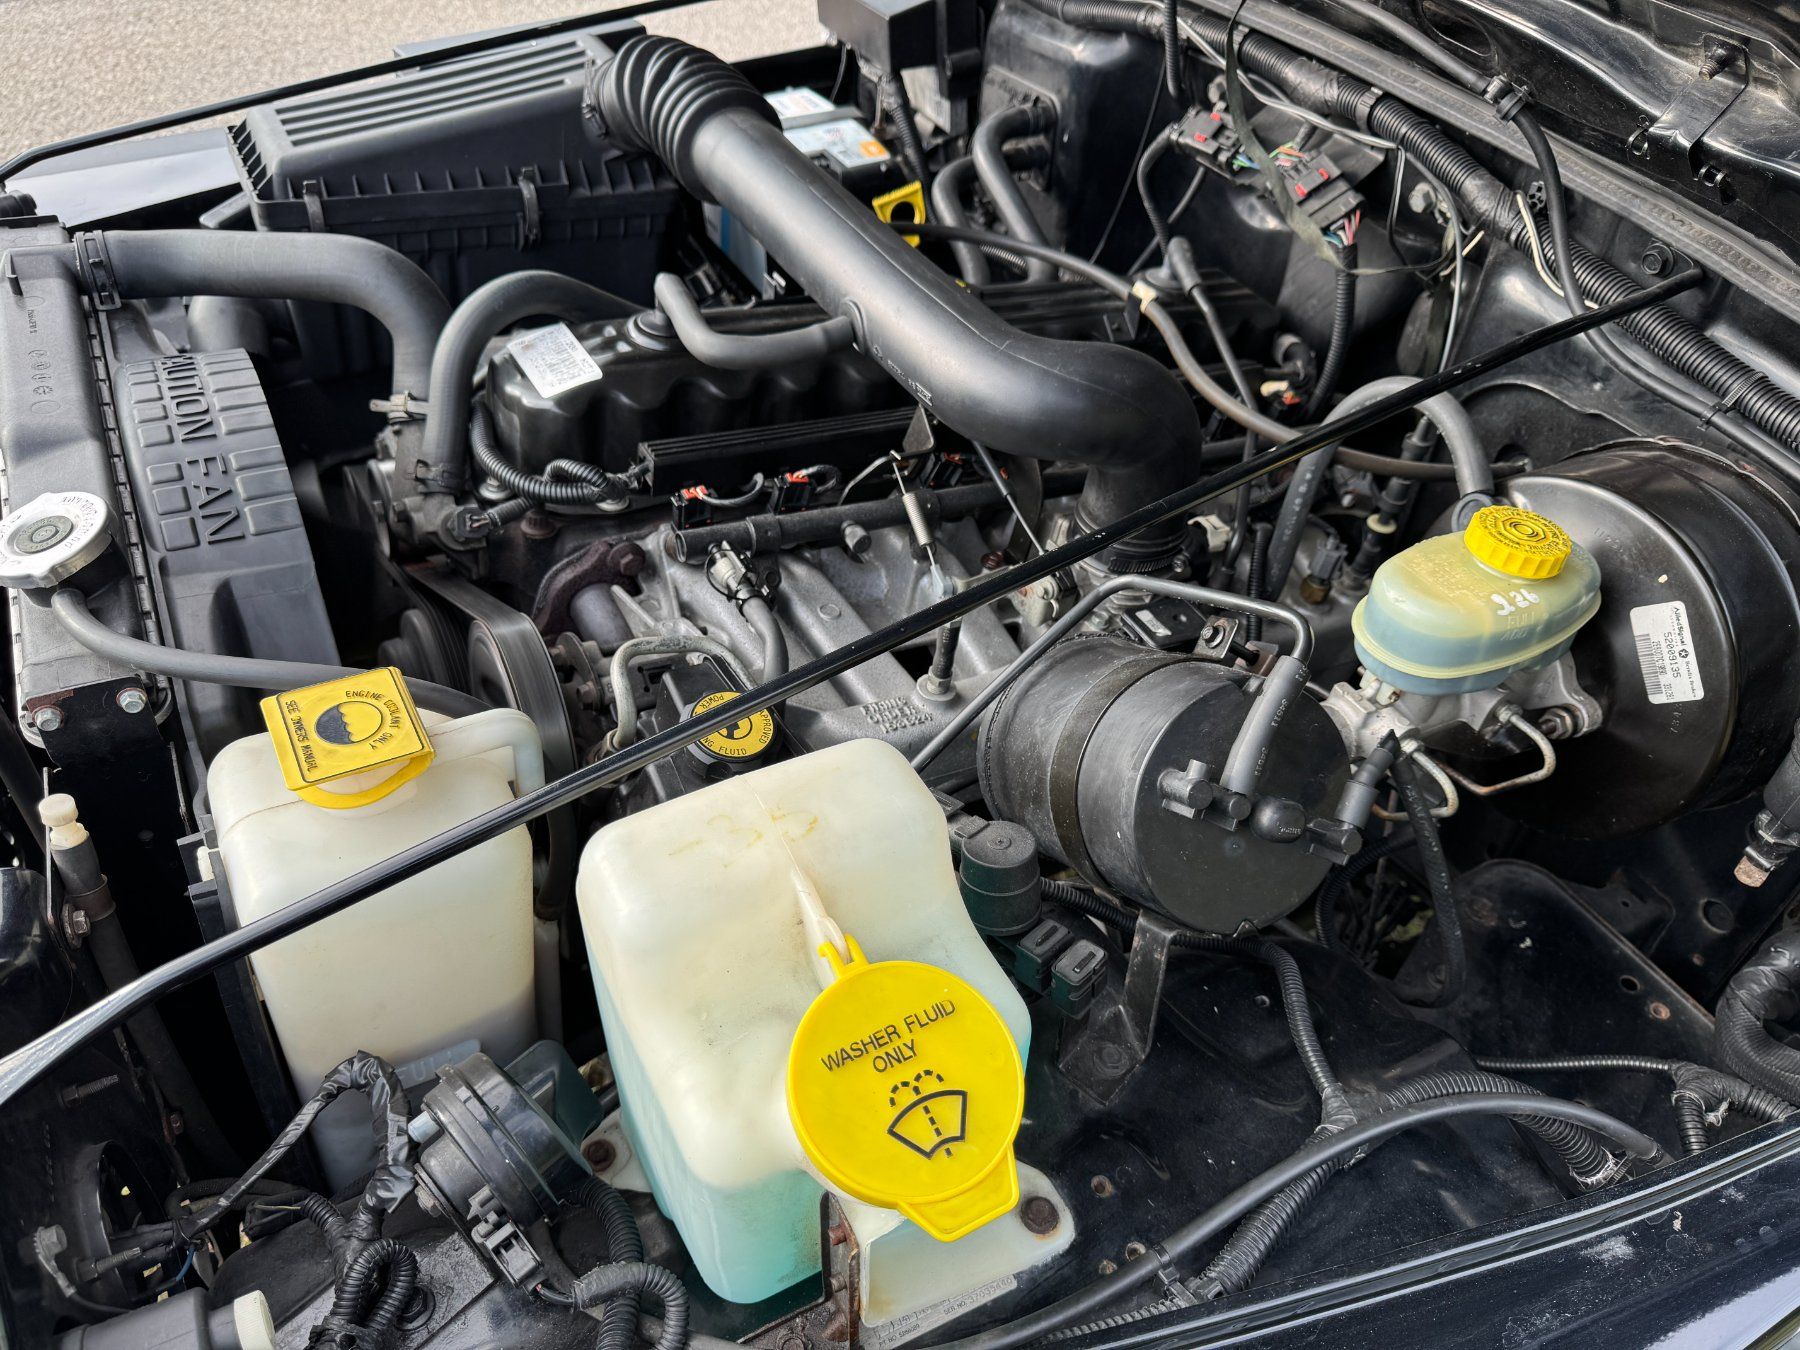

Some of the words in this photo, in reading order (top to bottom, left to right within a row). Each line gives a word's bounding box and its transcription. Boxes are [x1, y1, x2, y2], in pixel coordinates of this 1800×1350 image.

[185, 453, 246, 546] FAN
[1663, 631, 1682, 679] 52009135
[345, 689, 385, 702] ENGINE
[699, 693, 725, 710] POWER
[383, 699, 403, 730] COOLANT
[368, 731, 394, 751] ONLY
[718, 745, 747, 756] FLUID
[301, 742, 319, 772] MANUAL
[820, 1024, 902, 1072] WASHER
[903, 999, 956, 1034] FLUID
[872, 1038, 918, 1073] ONLY
